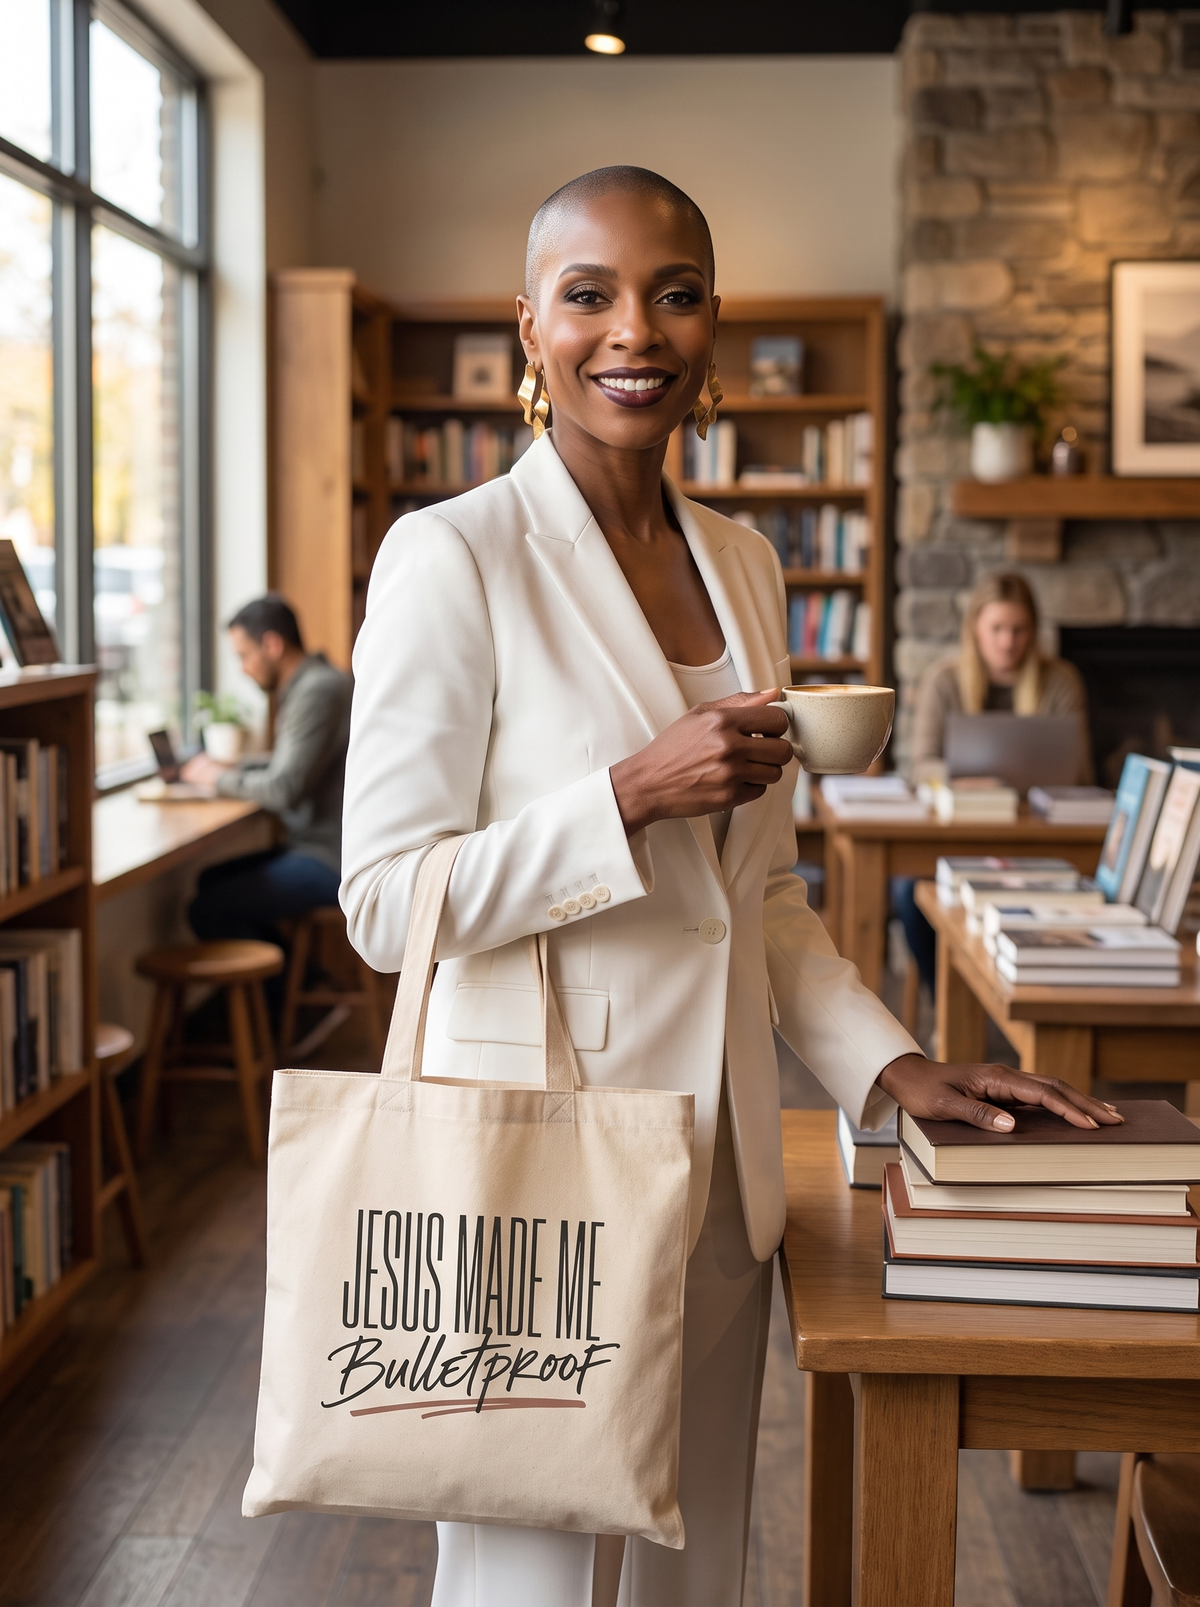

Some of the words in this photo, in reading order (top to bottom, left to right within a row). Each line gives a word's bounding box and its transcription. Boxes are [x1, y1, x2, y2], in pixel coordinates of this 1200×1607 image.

[342, 1209, 444, 1332] JESUS
[454, 1214, 547, 1338] MADE
[555, 1220, 605, 1341] ME
